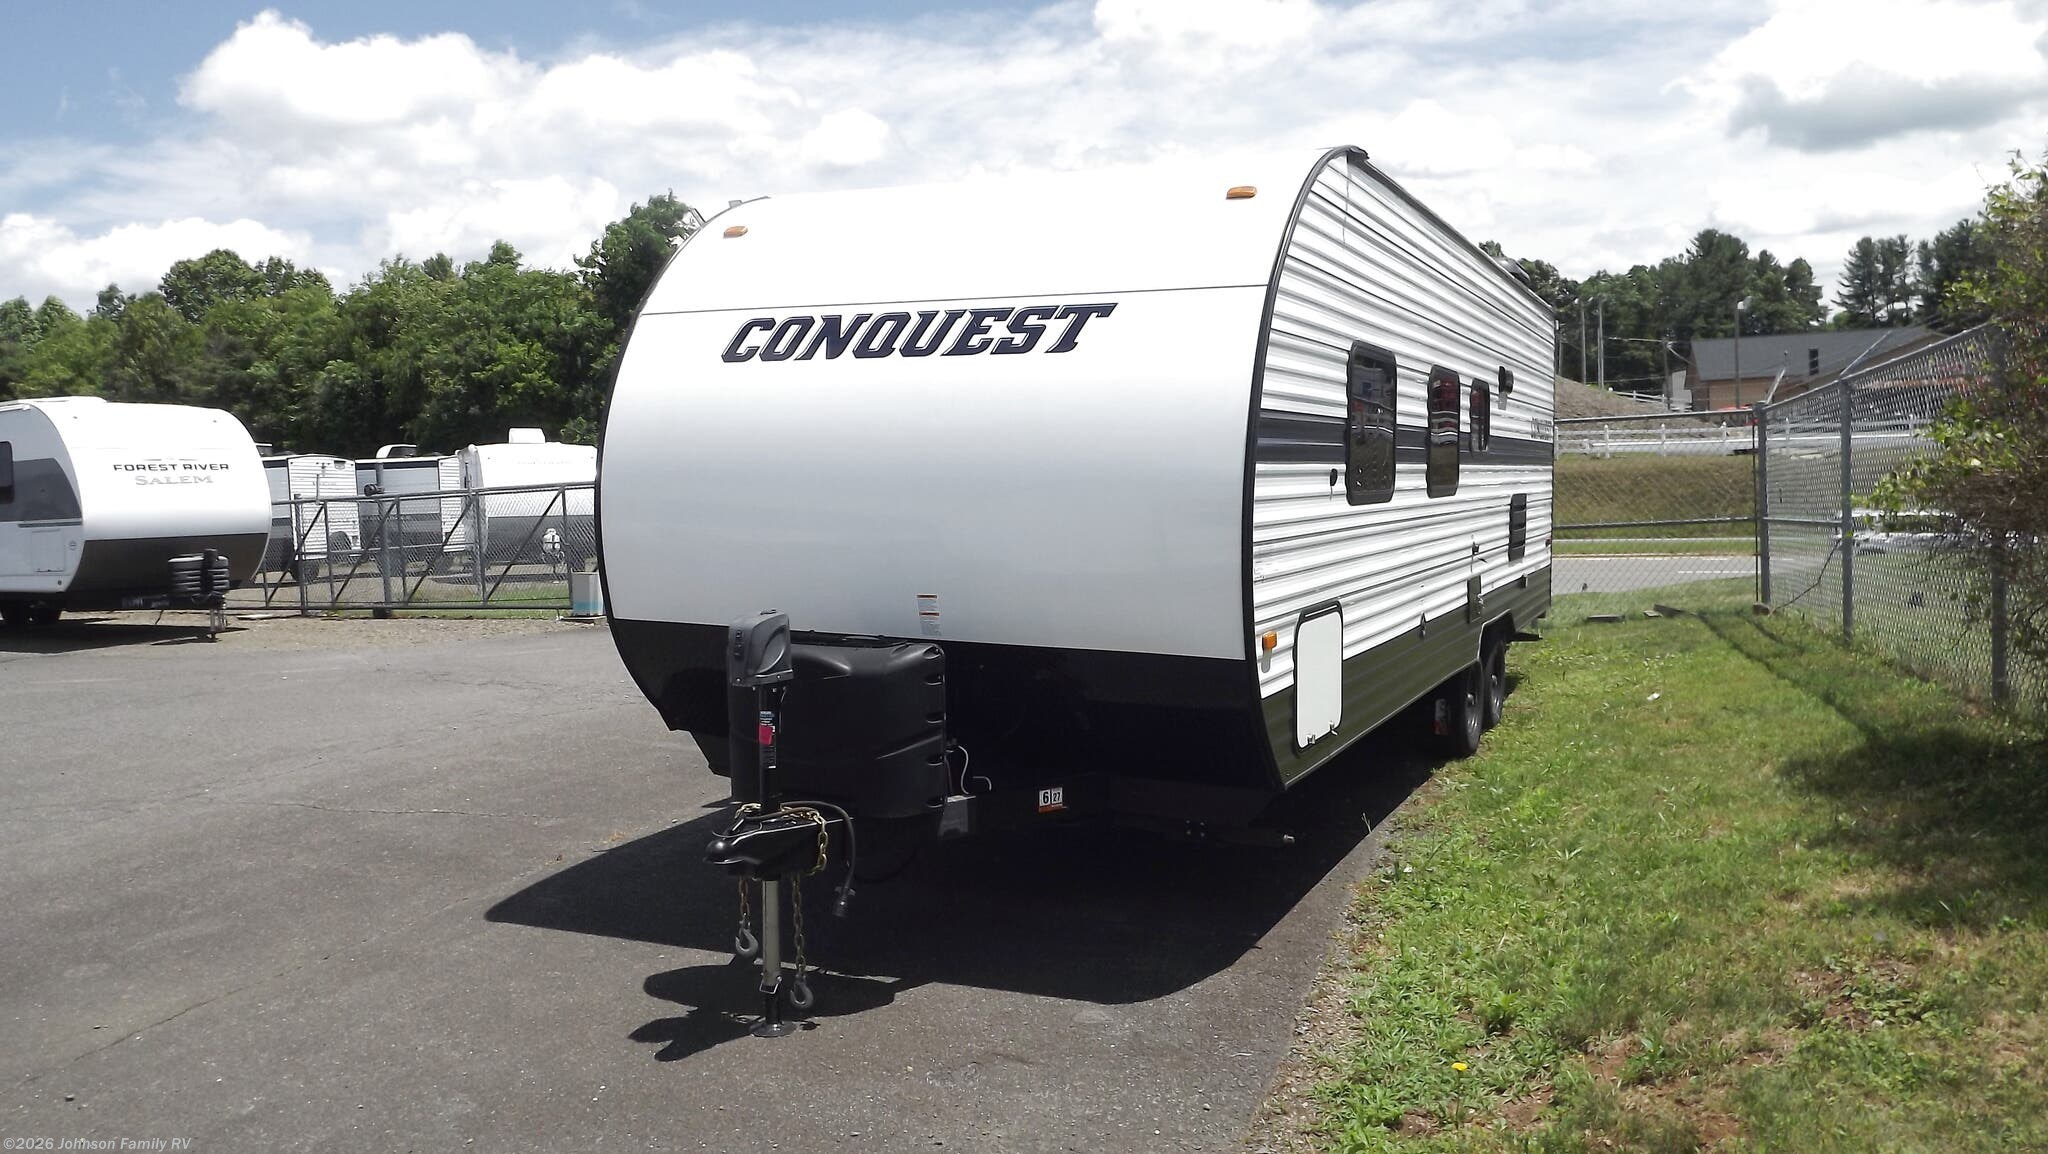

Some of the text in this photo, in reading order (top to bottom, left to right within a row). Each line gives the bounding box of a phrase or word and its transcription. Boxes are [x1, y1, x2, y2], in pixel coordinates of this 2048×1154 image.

[721, 302, 1118, 363] CONQUEST
[113, 463, 229, 472] FOREST RIVER
[135, 475, 214, 486] SALEM
